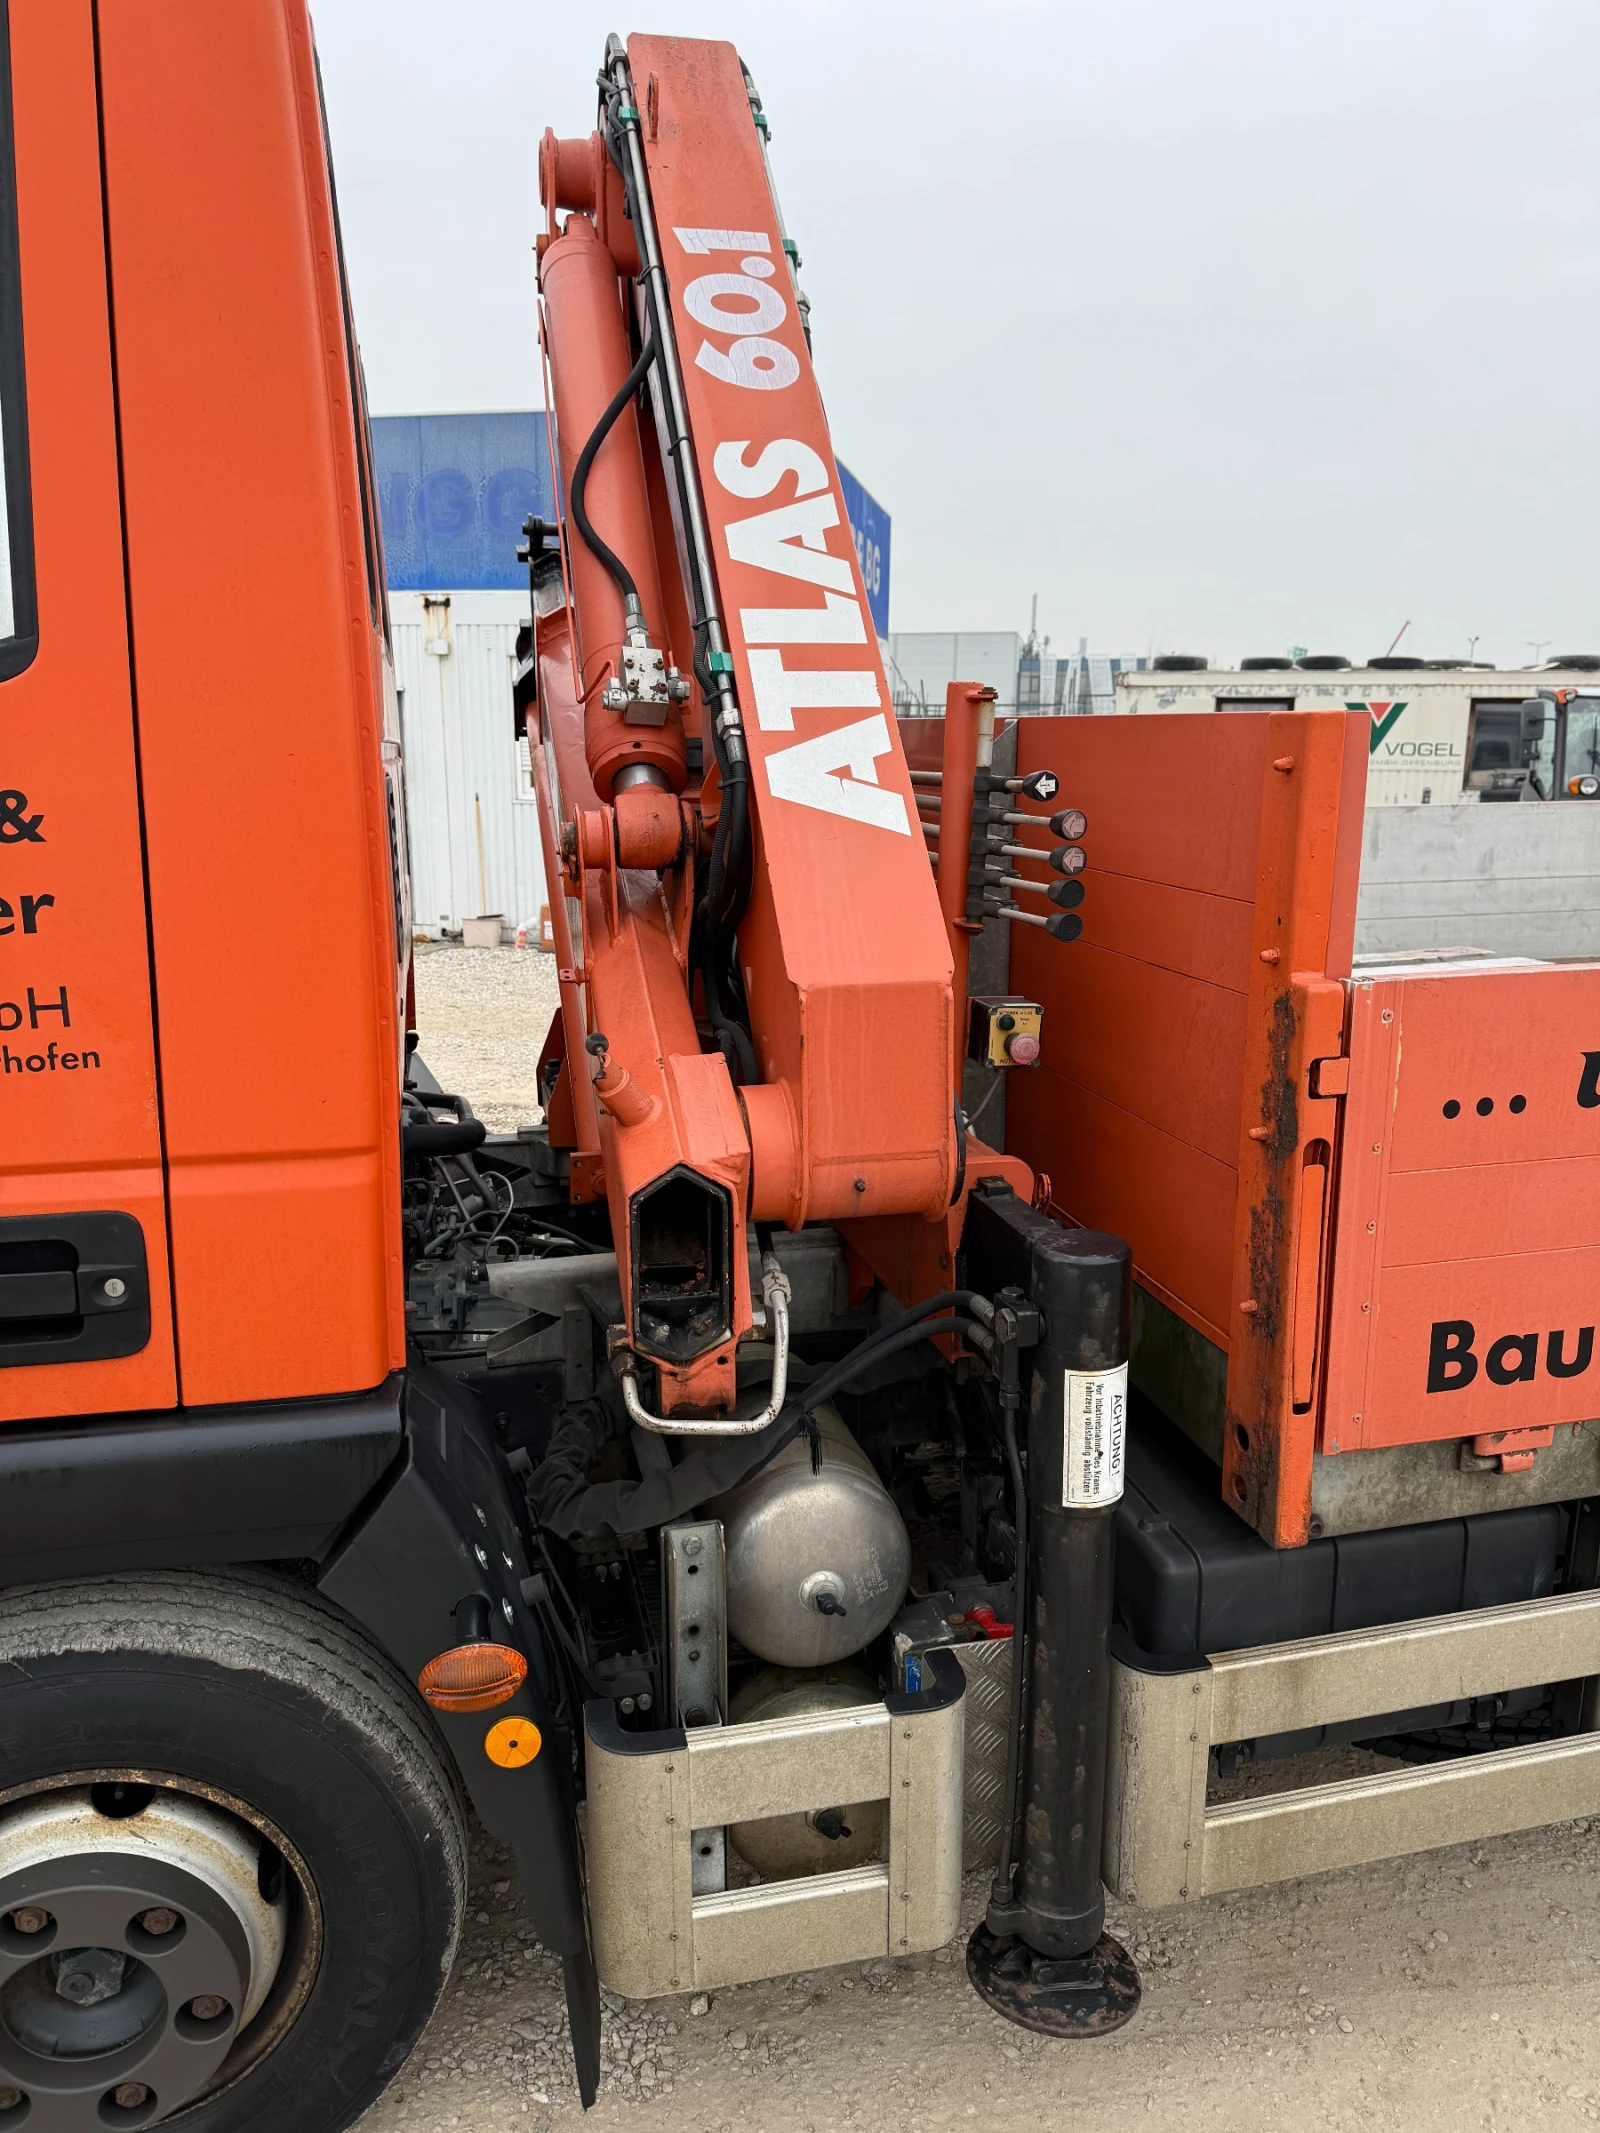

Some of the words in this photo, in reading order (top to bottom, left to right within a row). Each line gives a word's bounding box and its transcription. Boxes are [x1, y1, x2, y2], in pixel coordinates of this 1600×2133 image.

[672, 227, 800, 390] 60.1
[713, 438, 912, 836] ATLAS
[1385, 742, 1461, 757] VOGEL
[0, 789, 47, 844] &
[0, 1042, 100, 1074] hofen
[1426, 1319, 1595, 1394] Bau
[1083, 1382, 1095, 1414] Fahrzeug
[1095, 1383, 1104, 1396] Vor
[1082, 1417, 1094, 1456] vollständig
[1094, 1397, 1104, 1453] Inbetriebnahme
[1083, 1458, 1093, 1493] abstützen
[1093, 1471, 1102, 1495] Kranes
[257, 1746, 398, 2043] UNIROYAL
